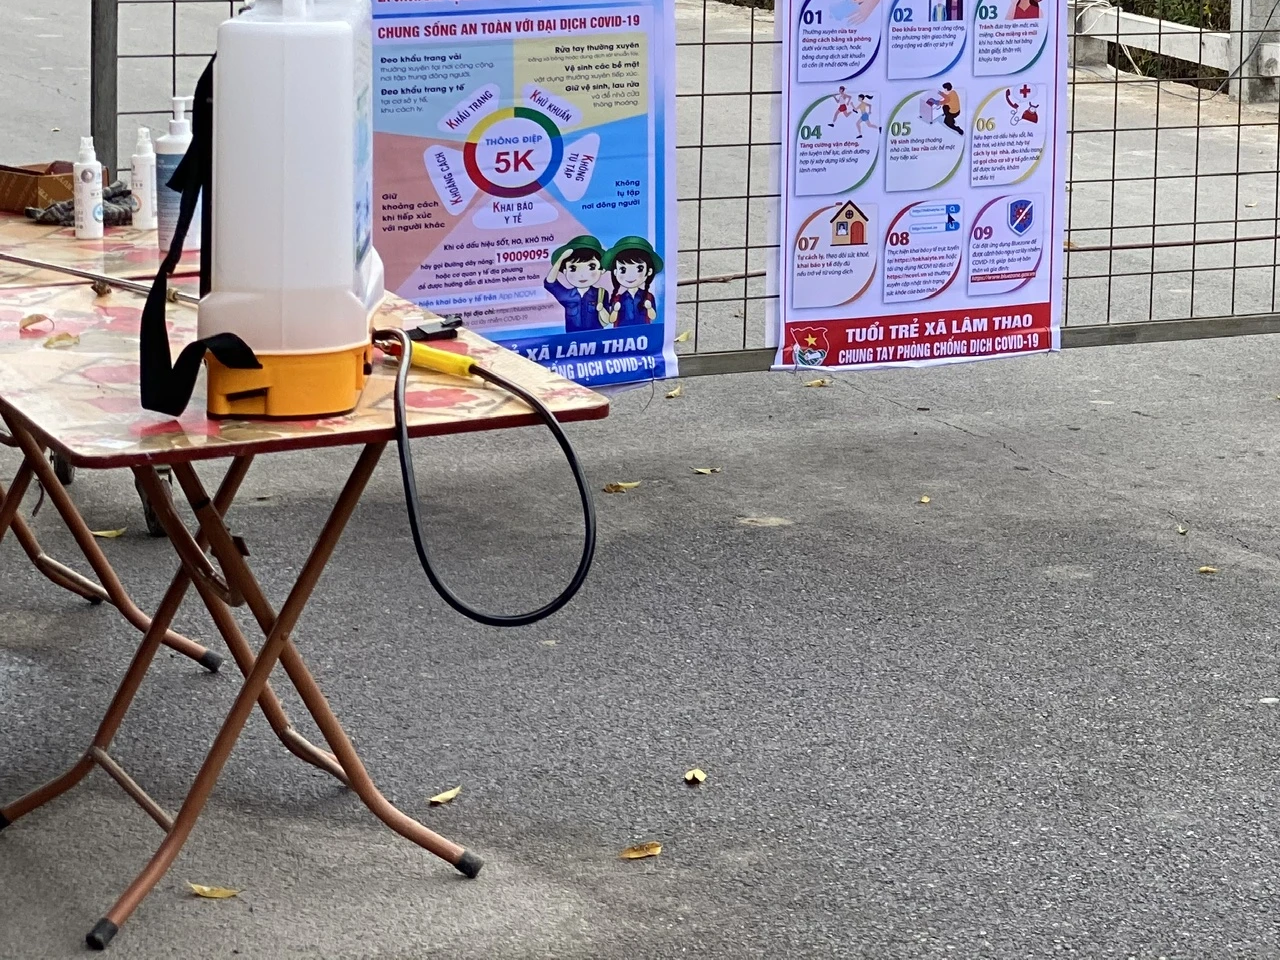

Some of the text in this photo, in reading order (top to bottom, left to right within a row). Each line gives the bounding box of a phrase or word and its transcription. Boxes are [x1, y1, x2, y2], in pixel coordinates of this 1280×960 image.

[803, 9, 822, 25] 01
[893, 7, 913, 22] 02
[978, 5, 998, 20] 03
[378, 14, 640, 39] CHUNG SỐNG AN TOÀN VỚI ĐẠI DỊCH COVID-19
[555, 45, 570, 53] Rửa
[572, 45, 585, 53] tay
[616, 42, 639, 50] xuyên
[380, 56, 398, 64] Đeo
[400, 54, 421, 63] khẩu
[400, 85, 422, 95] khẩu
[456, 83, 465, 91] tế
[565, 84, 579, 92] Giữ
[581, 84, 590, 92] vệ
[445, 90, 493, 130] KHẨU TRANG
[529, 89, 572, 123] KHỬ KHUẨN
[890, 121, 912, 137] 05
[976, 117, 996, 132] 06
[486, 134, 543, 146] THÔNG ĐIỆP
[800, 125, 822, 140] 04
[494, 149, 535, 174] 5K
[564, 152, 579, 179] TỤ TẬP
[576, 154, 595, 182] KHÔNG
[434, 151, 463, 205] KHOẢNG CÁCH
[626, 189, 640, 197] tập
[382, 202, 415, 210] khoảng
[493, 201, 533, 213] KHAI BÁO
[598, 201, 616, 209] đông
[618, 199, 640, 208] người
[397, 212, 414, 221] tiếp
[504, 212, 522, 224] Y TẾ
[382, 224, 396, 232] với
[397, 223, 422, 232] người
[973, 226, 993, 241] 09
[456, 242, 465, 250] có
[466, 241, 479, 249] dấu
[481, 240, 495, 248] hiệu
[496, 237, 510, 247] SỐT,
[525, 235, 540, 243] KHÓ
[541, 234, 554, 242] THỞ
[798, 236, 820, 251] 07
[889, 231, 910, 246] 08
[496, 248, 549, 263] 19009095
[418, 300, 434, 308] hiện
[453, 296, 467, 304] báo
[474, 293, 482, 302] tế
[845, 314, 1033, 343] TUỔI TRẺ XÃ LÂM THAO
[526, 344, 550, 361] XÃ
[556, 342, 597, 358] LÂM
[602, 335, 648, 353] THAO
[838, 333, 1039, 364] CHUNG TAY PHÒNG CHỐNG DỊCH COVID-19
[577, 360, 603, 381] DỊCH
[606, 356, 655, 374] COVID-19
